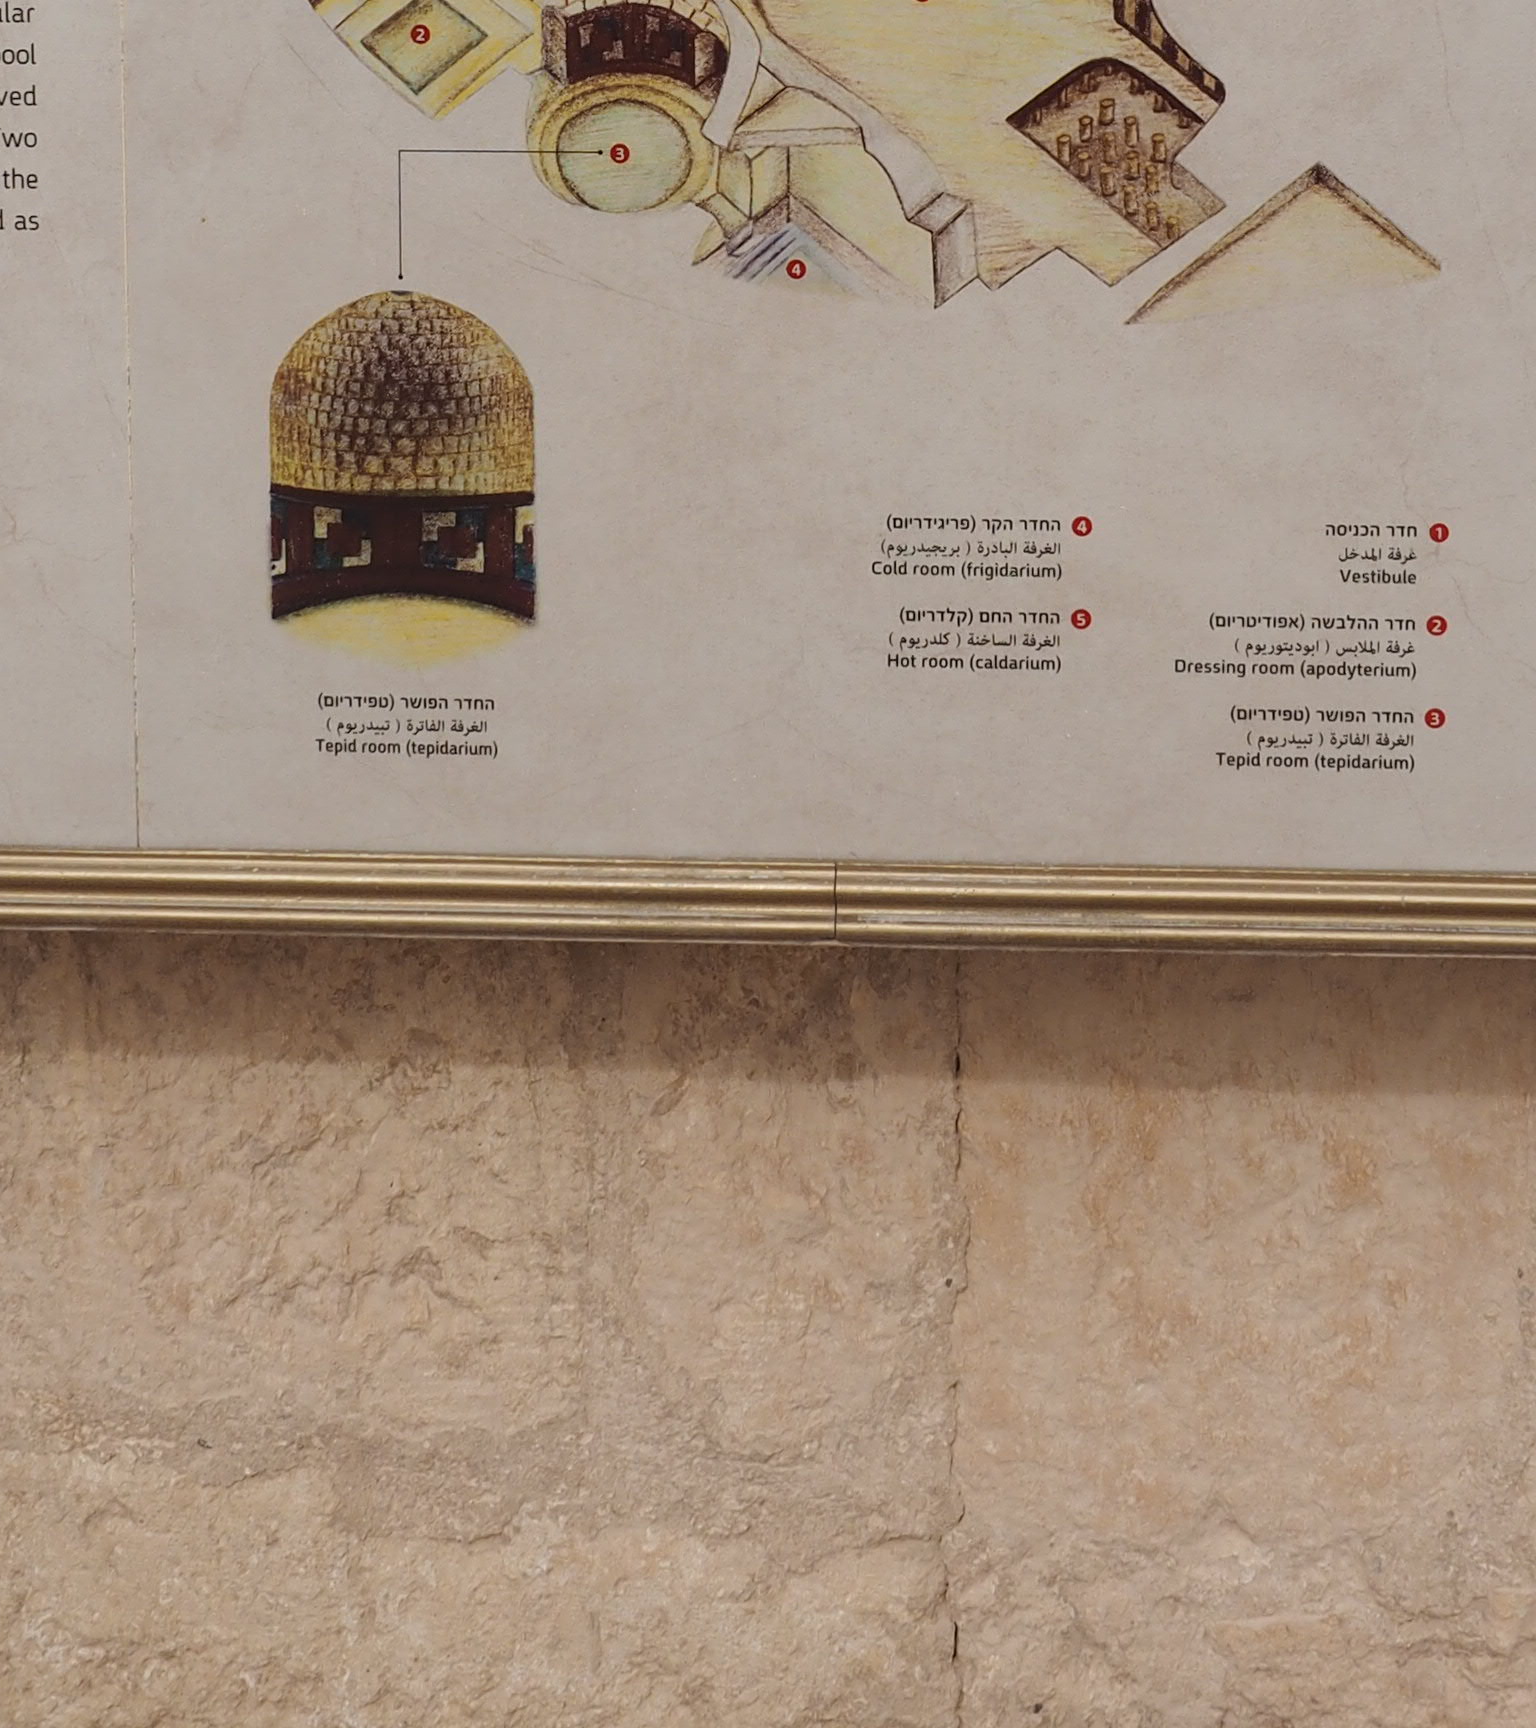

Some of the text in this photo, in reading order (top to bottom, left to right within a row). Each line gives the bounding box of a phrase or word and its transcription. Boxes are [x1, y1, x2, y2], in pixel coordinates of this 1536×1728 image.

[415, 28, 426, 42] 2
[615, 147, 625, 160] 3
[2, 167, 38, 189] the
[14, 215, 39, 231] as
[791, 263, 801, 276] 4
[887, 514, 1061, 535] החדר הקר (פריגידריום)
[1077, 520, 1087, 533] 4
[1325, 524, 1417, 537] חדר הכניסה
[1436, 527, 1442, 539] 1
[872, 560, 1062, 581] Cold room (frigidarium)
[1340, 569, 1416, 584] Vestibule
[899, 606, 1060, 627] החדר החם (קלדריום)
[1077, 613, 1086, 626] 5
[1209, 612, 1415, 632] חדר ההלבשה (אפודיטריום)
[1432, 620, 1441, 632] 2
[888, 653, 1061, 674] Hot room (caldarium)
[1175, 659, 1416, 681] Dressing room (apodyterium)
[318, 692, 494, 712] החדר הפושר (טפידריום)
[1230, 705, 1414, 725] החדר הפושר (טפידריום)
[1430, 712, 1439, 725] 3
[315, 738, 498, 759] Tepid room (tepidarium)
[1216, 752, 1415, 773] Tepid room (tepidarium)
